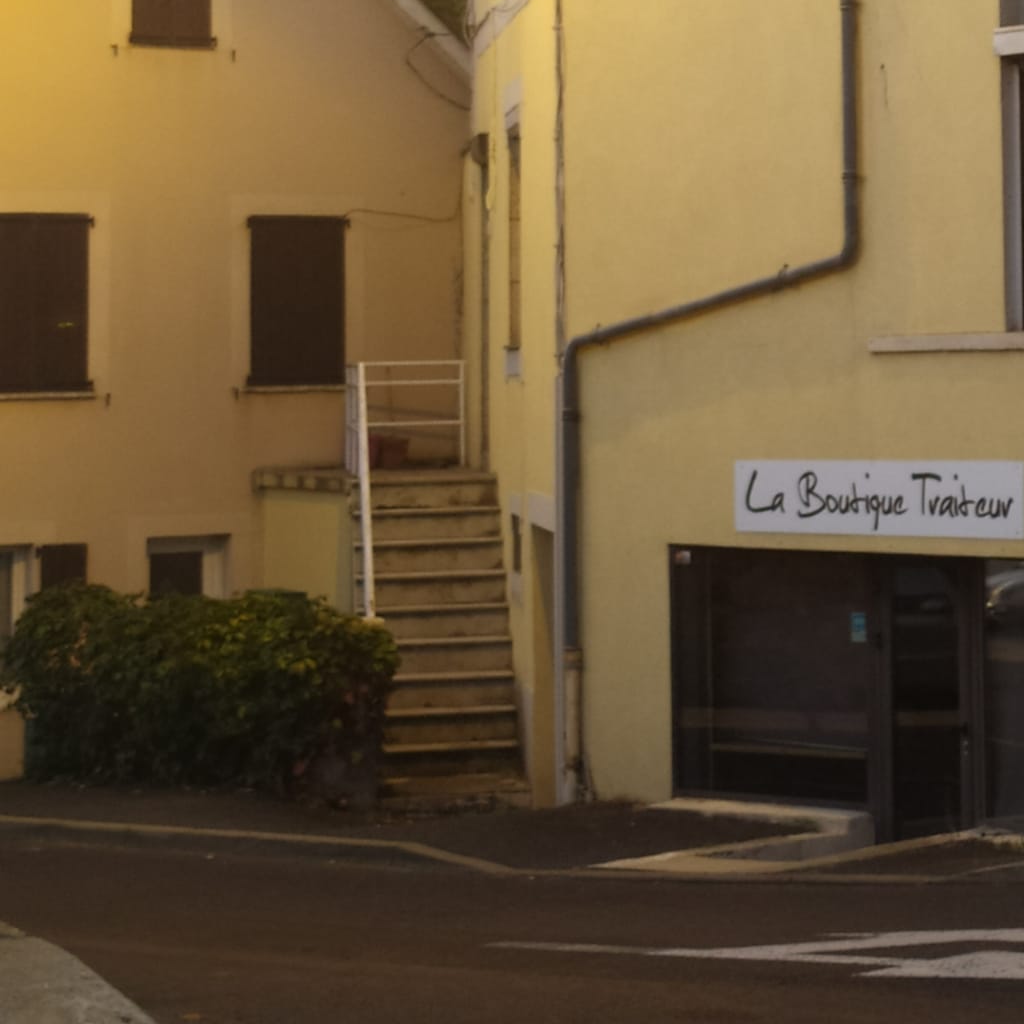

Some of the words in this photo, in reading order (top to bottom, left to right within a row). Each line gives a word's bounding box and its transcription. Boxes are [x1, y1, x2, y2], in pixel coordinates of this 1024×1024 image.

[745, 469, 786, 514] La
[796, 470, 908, 532] Boutique
[911, 472, 1014, 519] Traiteur
